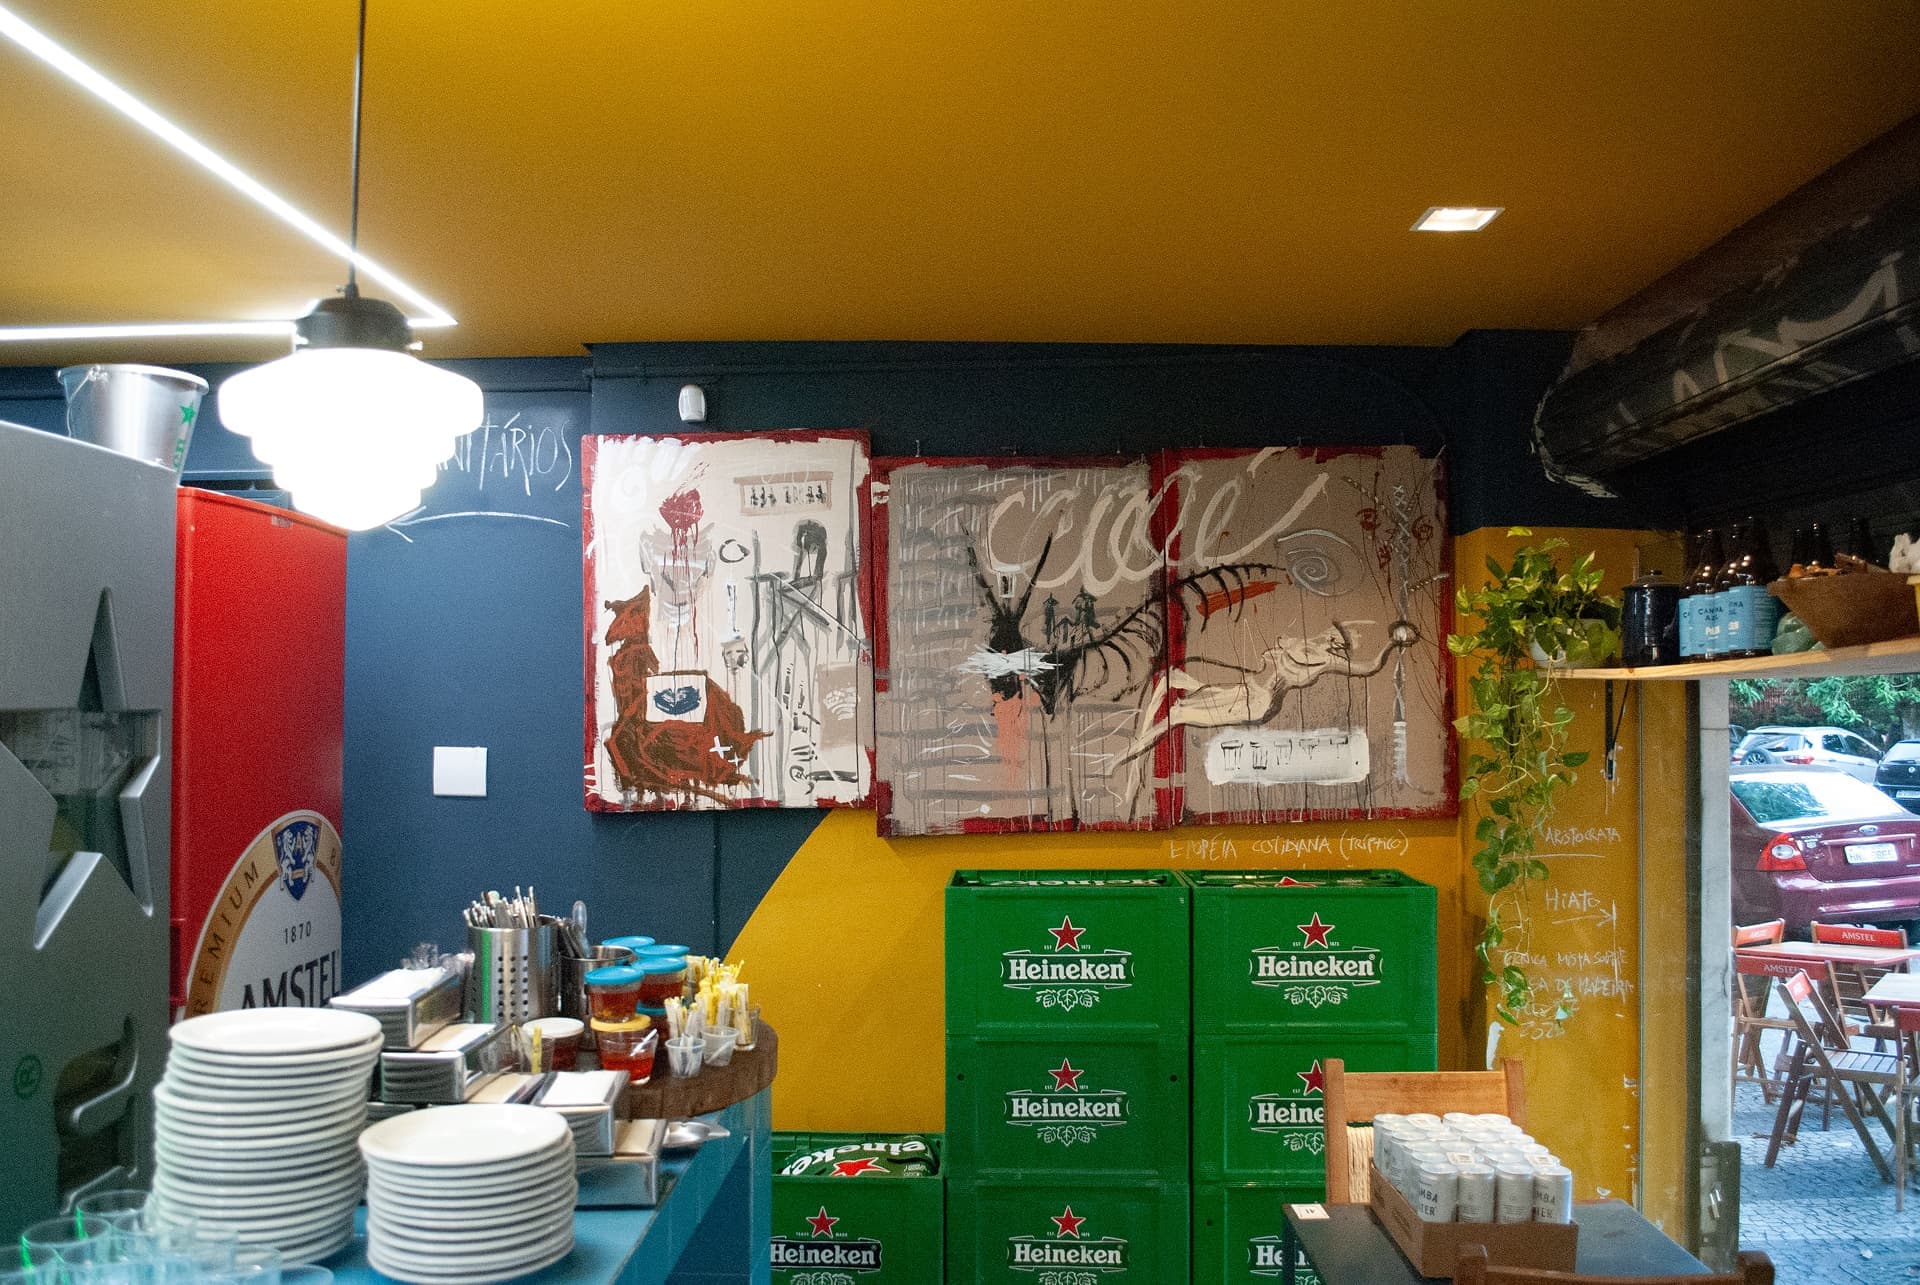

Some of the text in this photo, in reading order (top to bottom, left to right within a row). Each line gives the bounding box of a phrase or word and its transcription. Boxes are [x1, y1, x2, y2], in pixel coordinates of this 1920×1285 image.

[284, 921, 312, 944] 1870
[1841, 931, 1876, 942] AMSTEL
[1009, 959, 1126, 980] Heineken
[1257, 955, 1374, 977] Heineken
[1012, 1098, 1121, 1118] Heineken
[770, 1243, 876, 1265] Heineken
[1013, 1243, 1122, 1265] Heineken
